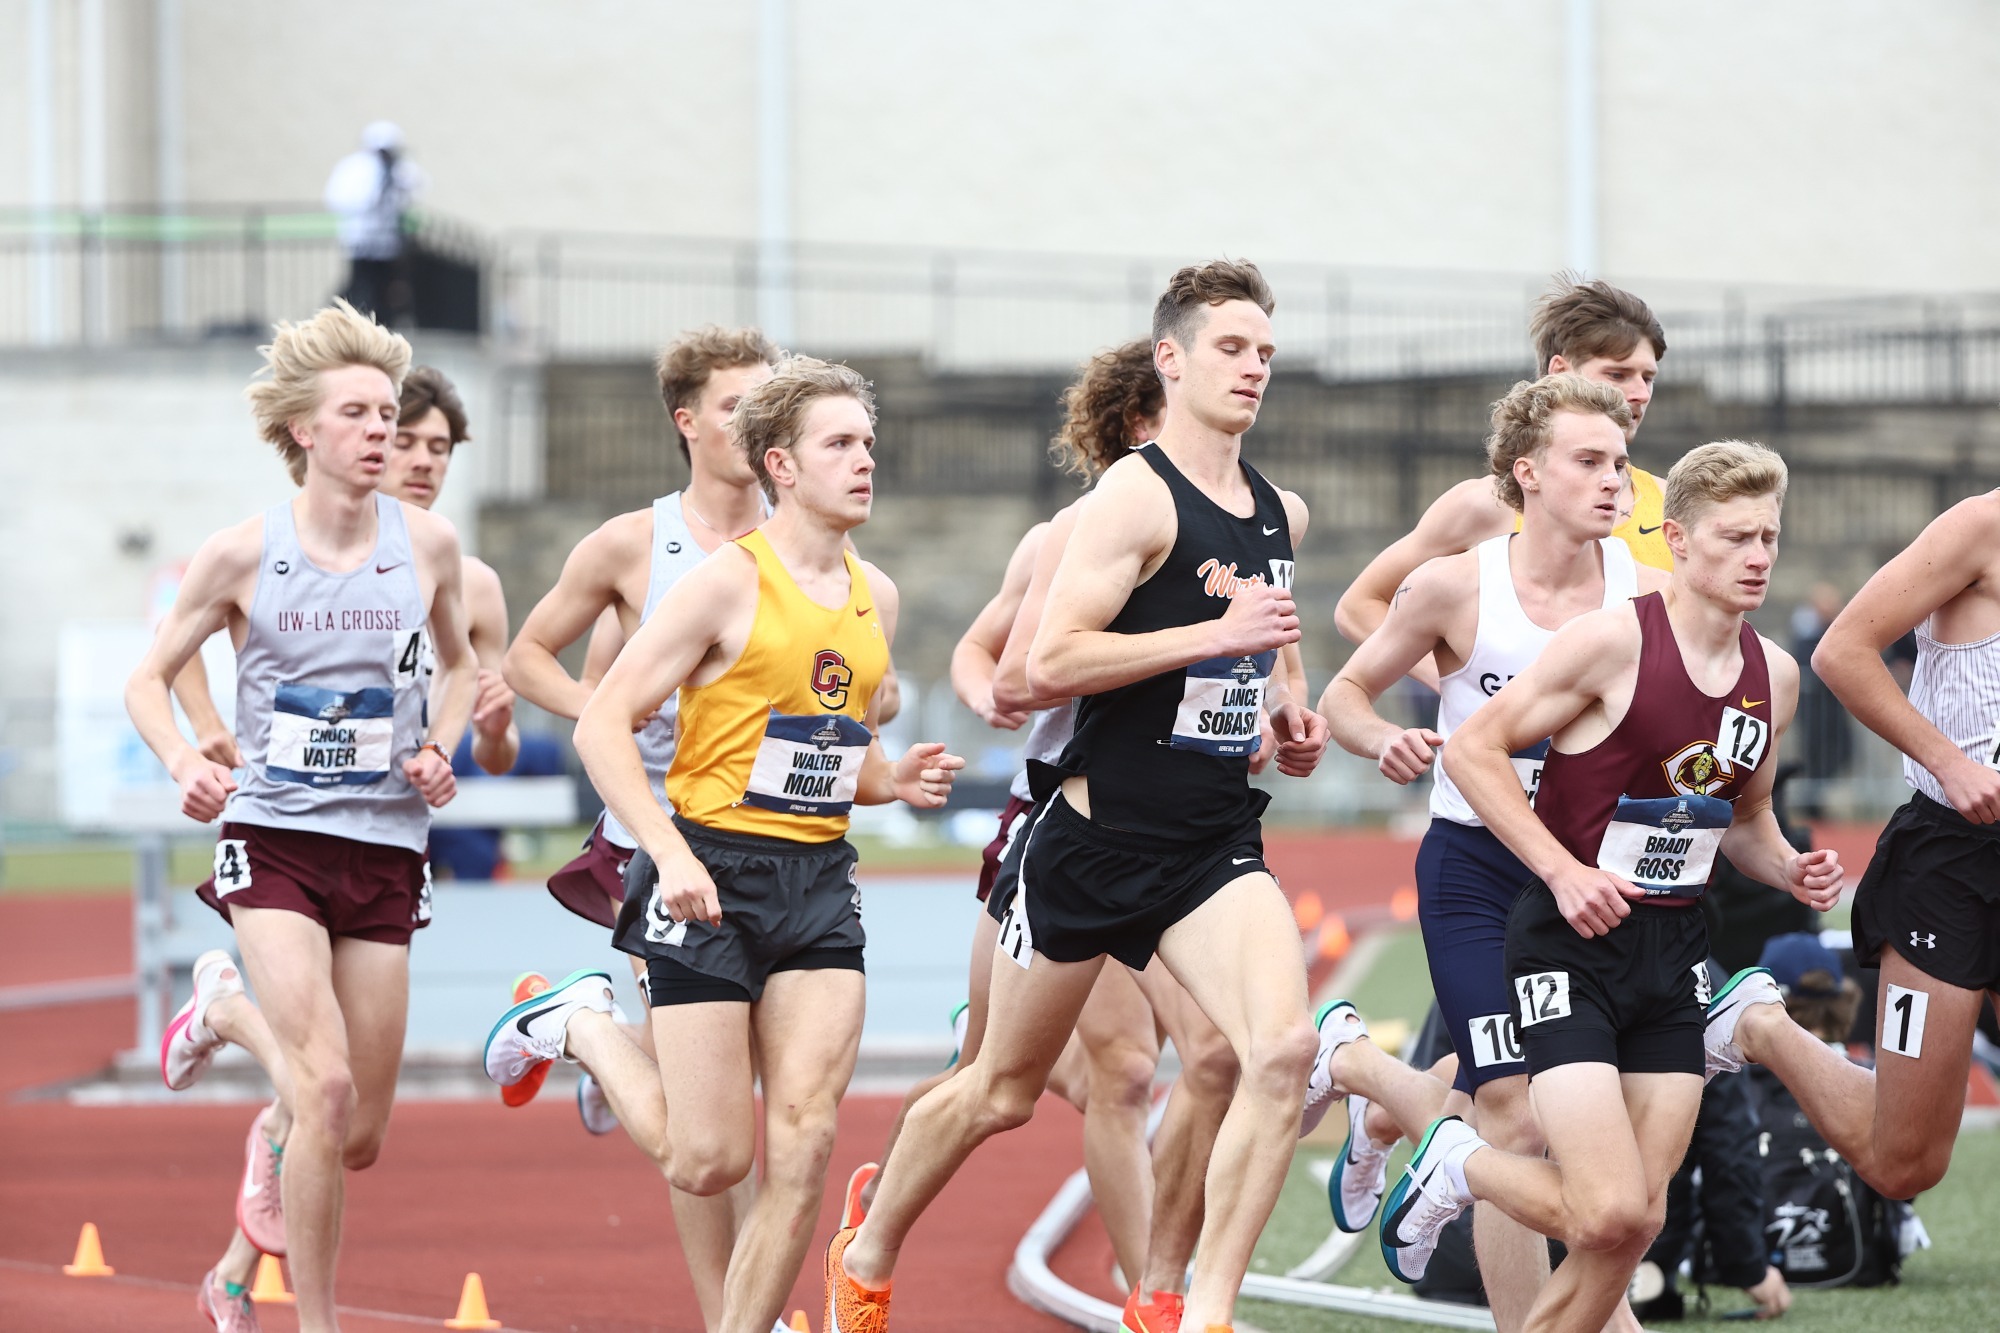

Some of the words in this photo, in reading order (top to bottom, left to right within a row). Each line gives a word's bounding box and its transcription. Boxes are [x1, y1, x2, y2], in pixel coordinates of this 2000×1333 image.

[1197, 558, 1266, 599] Wart
[279, 611, 335, 632] UW-LA
[342, 609, 401, 631] CROSSE
[398, 631, 421, 677] 4
[1221, 688, 1259, 707] LANCE
[303, 746, 357, 768] VATER
[1732, 714, 1761, 767] 12
[792, 751, 842, 771] WALTER
[783, 773, 837, 798] MOAK
[1644, 835, 1694, 855] BRADY
[219, 843, 243, 885] 4
[1633, 857, 1686, 880] GOSS
[1522, 974, 1561, 1022] 12
[1481, 1015, 1526, 1062] 10
[1894, 993, 1914, 1052] 1
